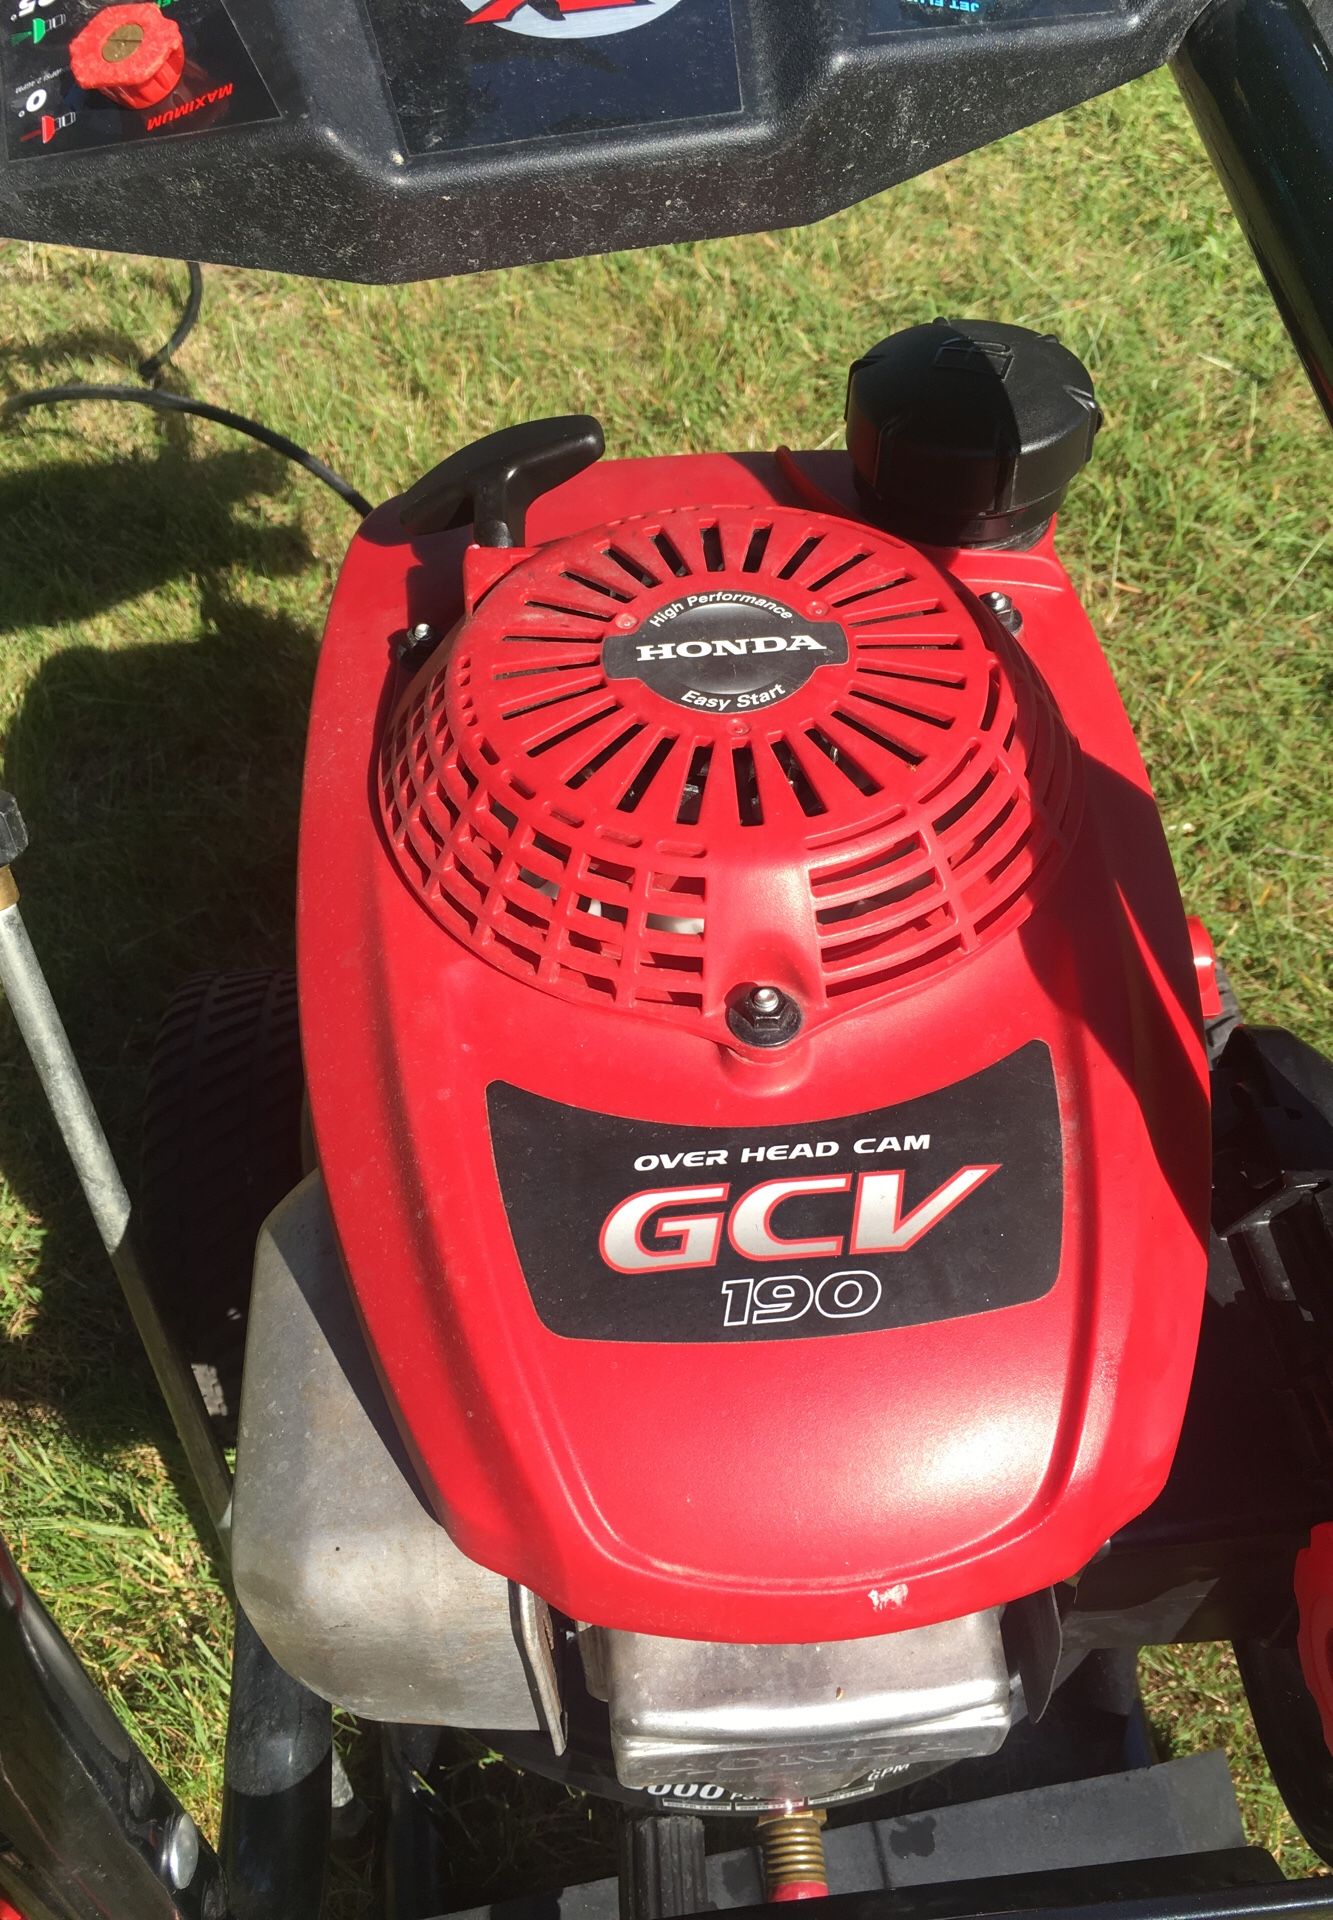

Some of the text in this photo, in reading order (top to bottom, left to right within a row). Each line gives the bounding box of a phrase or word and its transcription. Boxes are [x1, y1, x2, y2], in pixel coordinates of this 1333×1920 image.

[949, 0, 979, 12] JET
[147, 83, 233, 131] MAXIMUM
[650, 591, 793, 628] High Performance
[636, 635, 827, 662] HONDA
[681, 683, 786, 711] Easy Start
[633, 1134, 931, 1172] OVER HEAD CAM
[599, 1163, 1003, 1275] GCV
[721, 1269, 882, 1327] 190
[867, 1763, 910, 1781] GPM
[624, 1783, 725, 1800] 000
